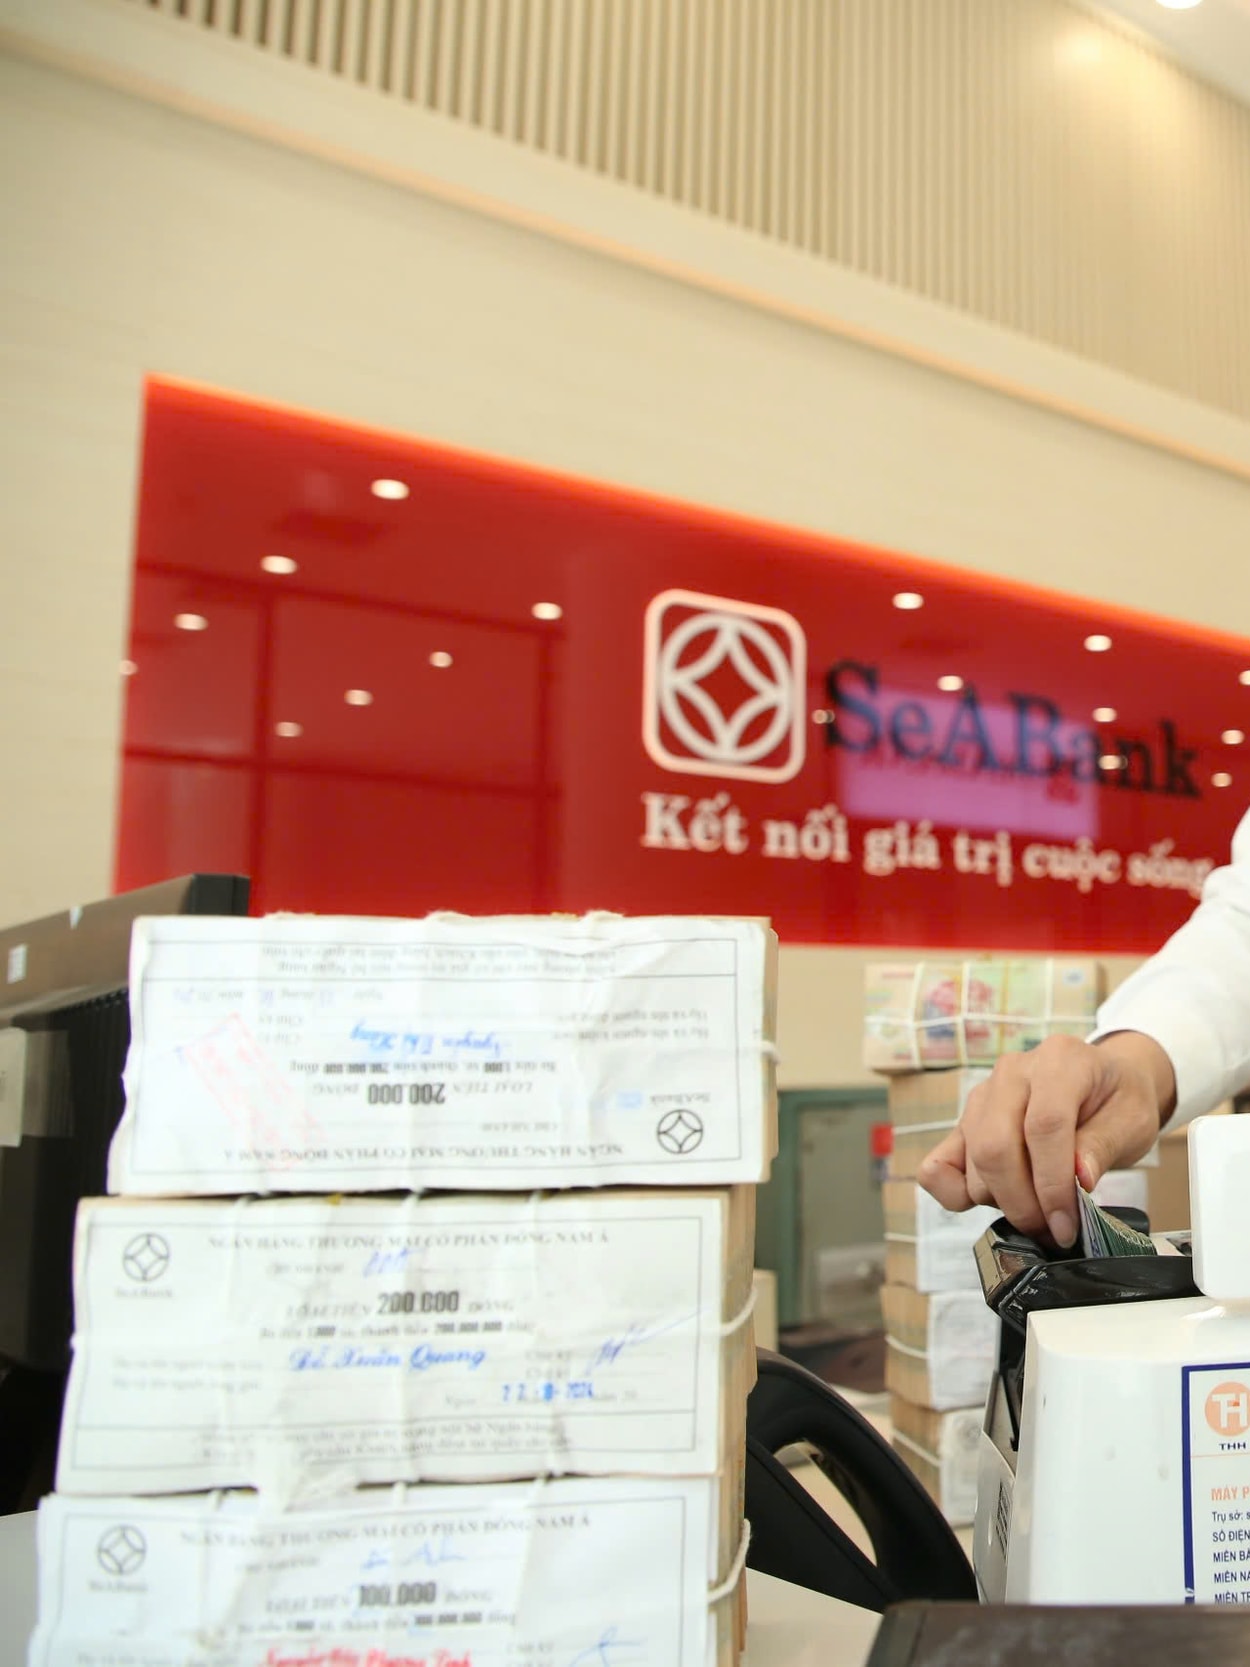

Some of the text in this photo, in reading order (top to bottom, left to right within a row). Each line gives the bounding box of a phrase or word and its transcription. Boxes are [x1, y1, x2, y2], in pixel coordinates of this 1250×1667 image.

[825, 658, 1201, 800] SeABank
[641, 792, 748, 851] Kết
[762, 805, 851, 864] nối
[864, 819, 940, 876] giá
[953, 832, 1013, 888] trị
[1023, 838, 1121, 893] cuộc
[367, 1082, 446, 1105] 200.000
[1218, 1441, 1247, 1450] THH
[1211, 1484, 1238, 1501] MÁY
[1212, 1510, 1227, 1523] Trụ
[1212, 1529, 1226, 1542] SỐ
[1228, 1528, 1250, 1544] ĐIỆN
